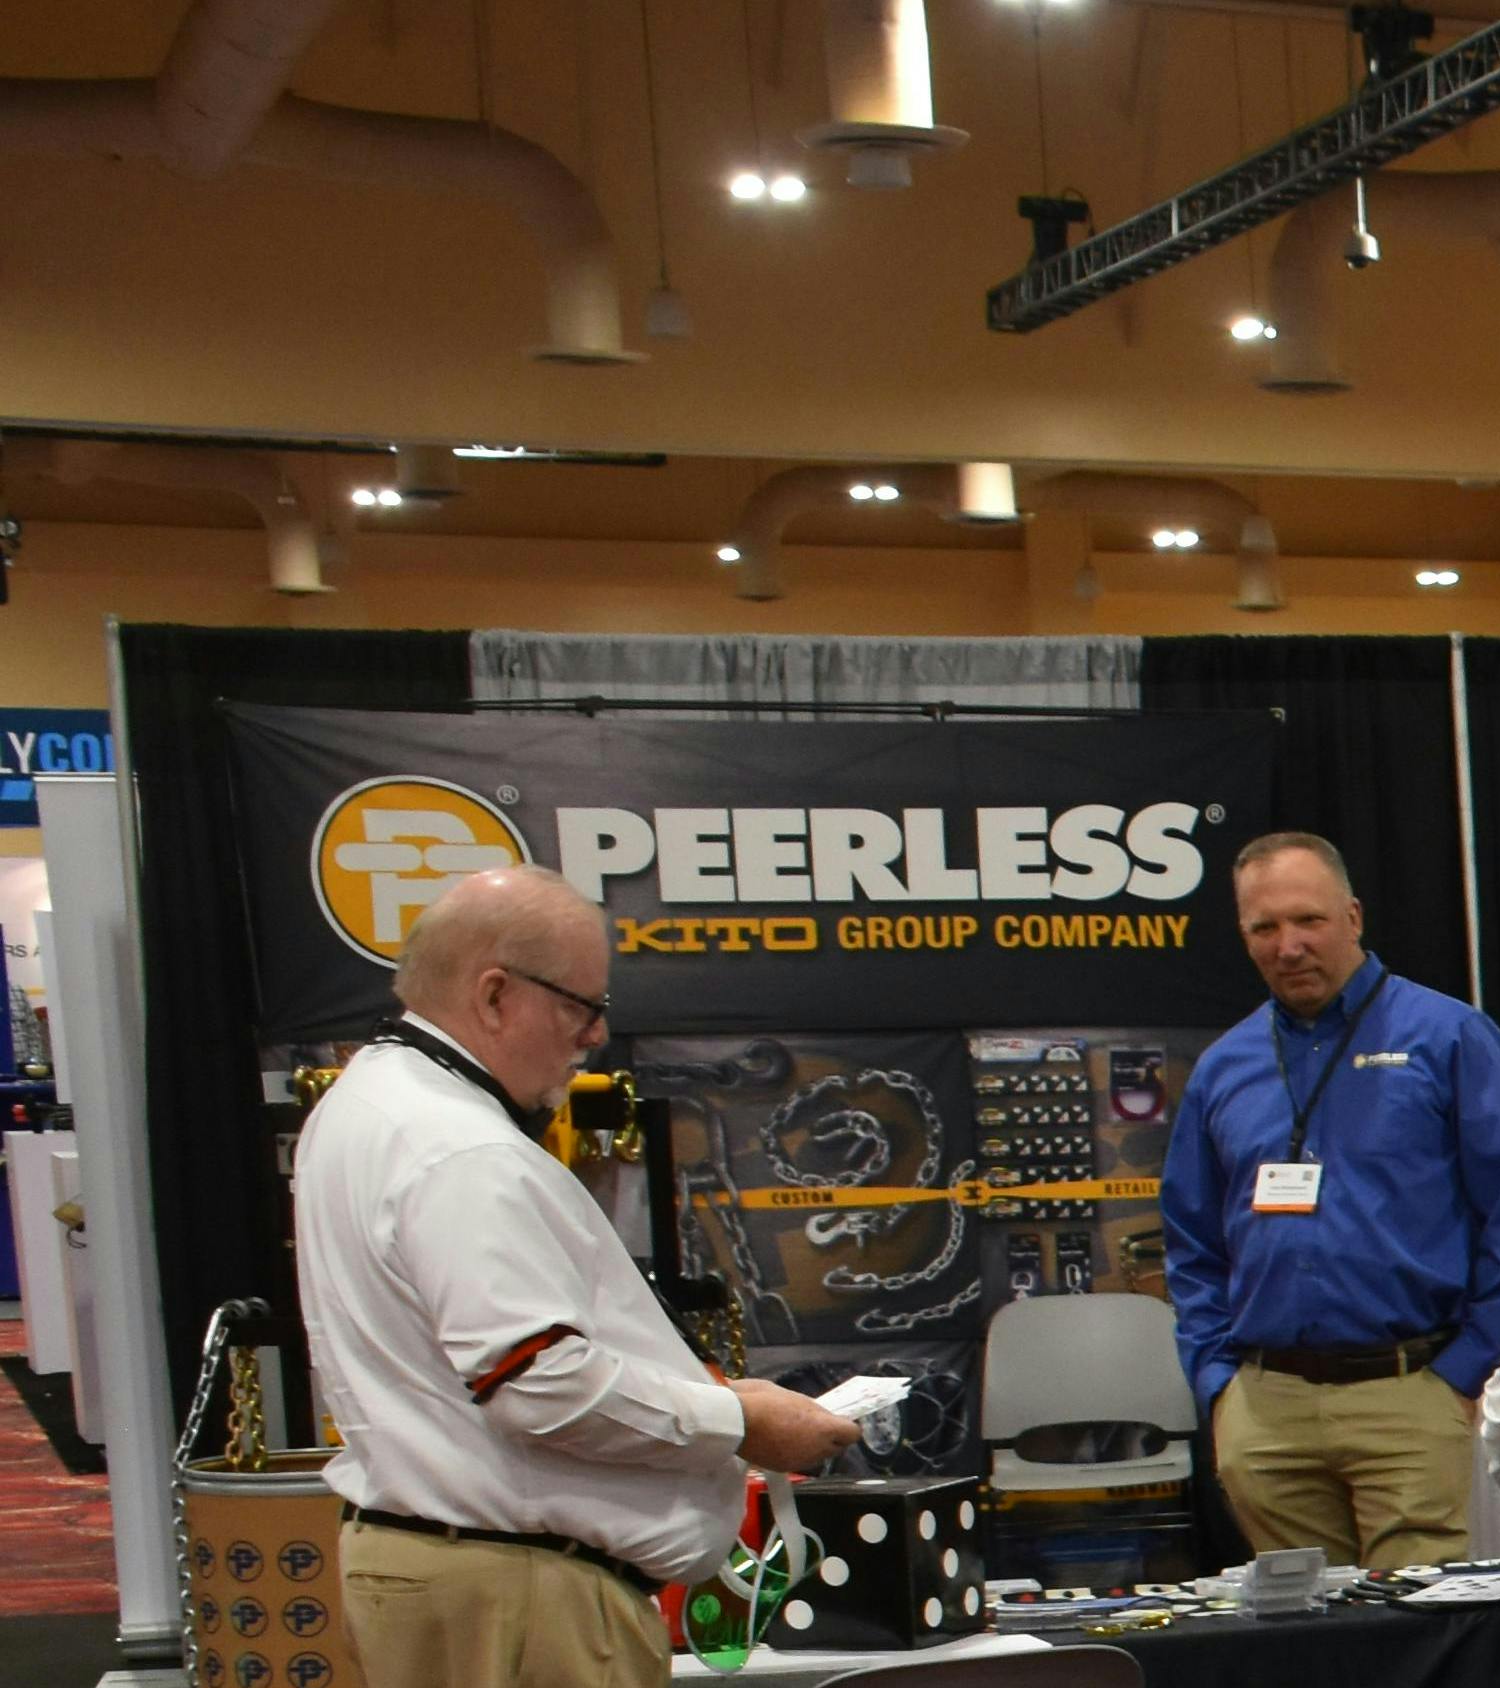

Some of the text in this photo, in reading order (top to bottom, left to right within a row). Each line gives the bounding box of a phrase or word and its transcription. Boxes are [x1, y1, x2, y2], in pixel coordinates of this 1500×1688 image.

[556, 802, 1204, 903] PEERLESS
[615, 914, 1190, 952] KITO GROUP COMPANY
[771, 1190, 834, 1206] CUSTOM
[1105, 1181, 1160, 1196] RETAIL
